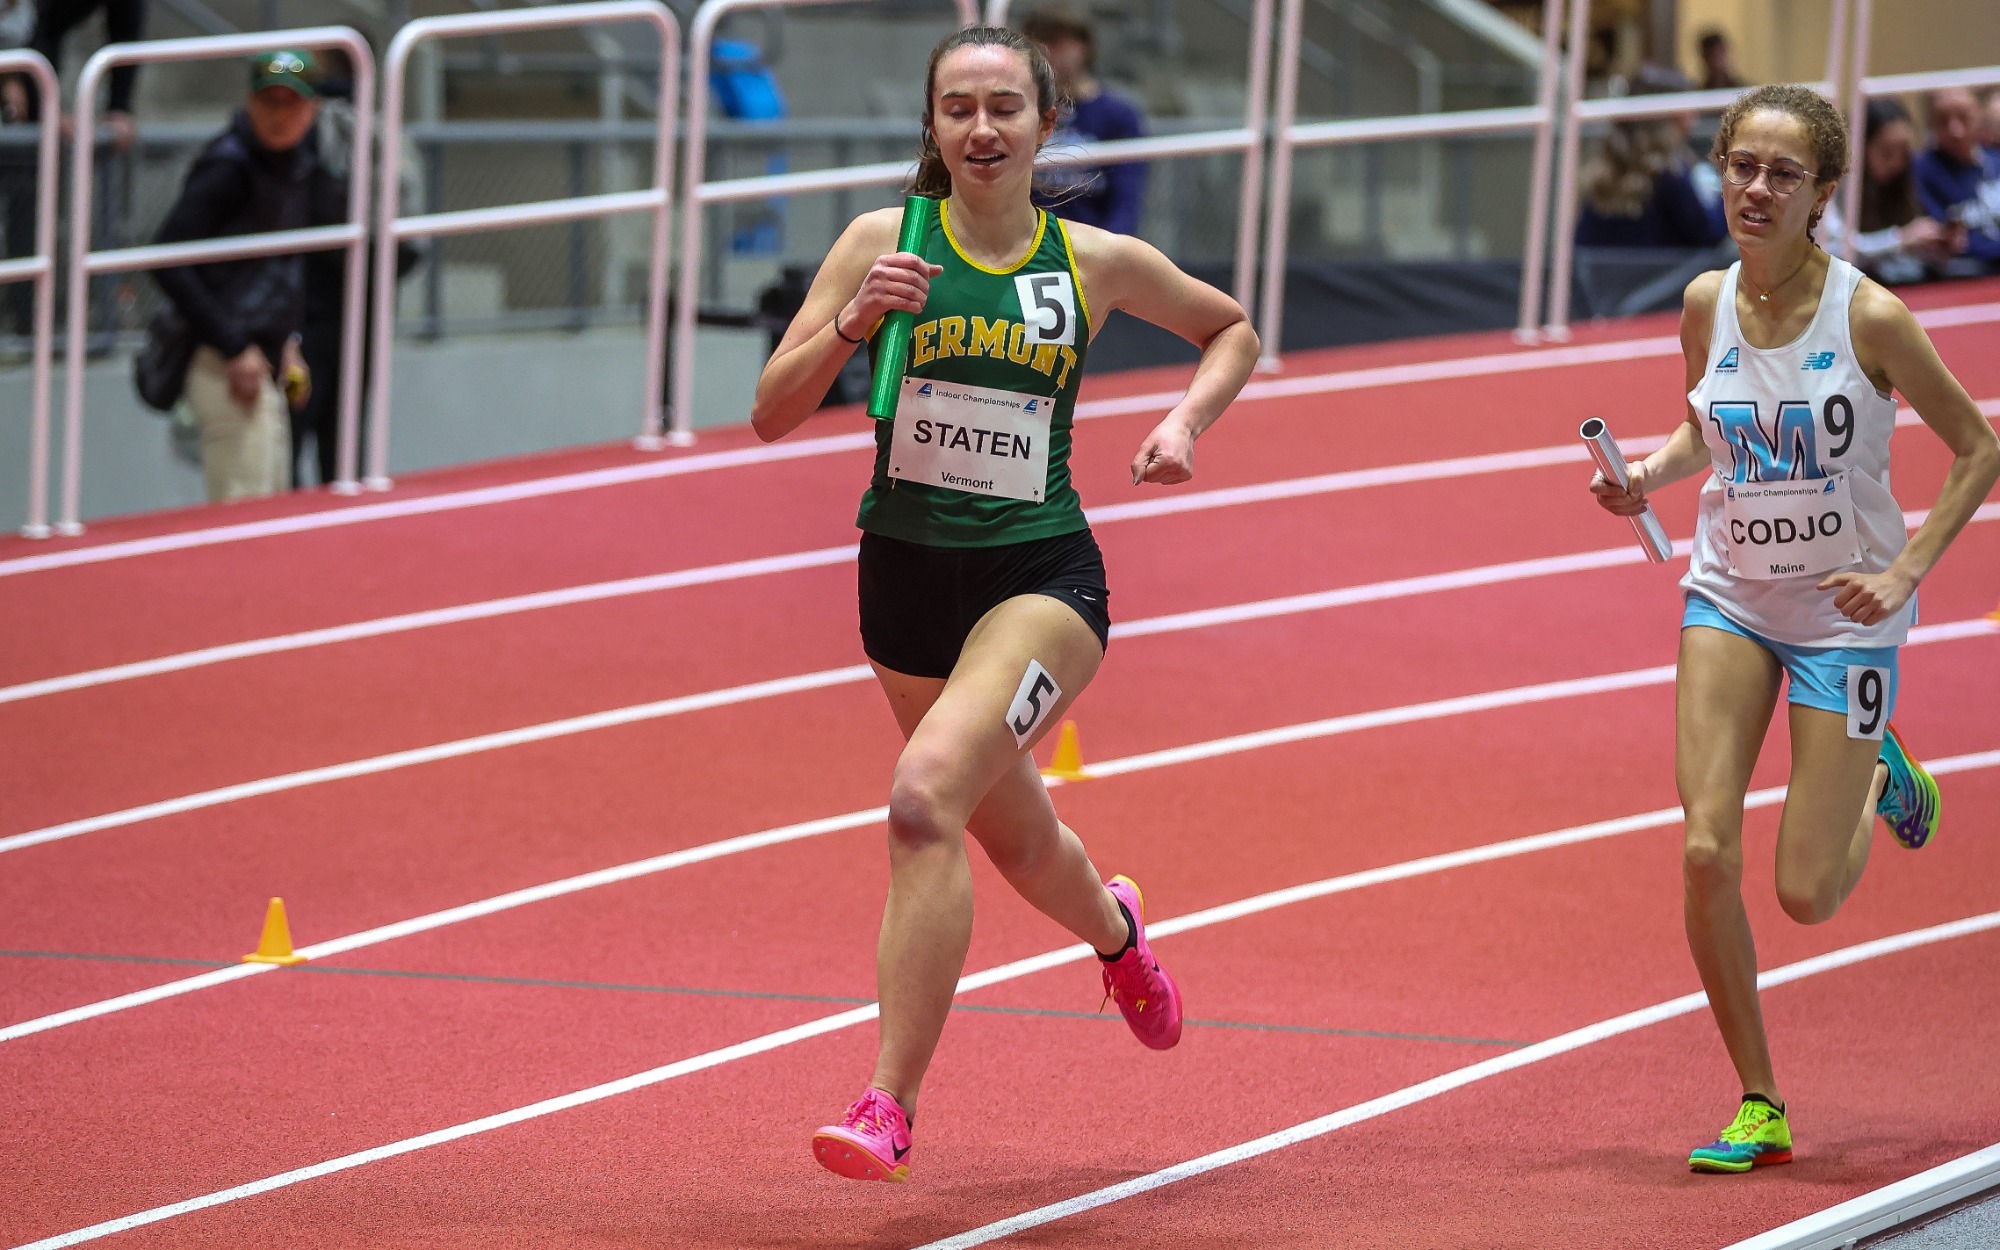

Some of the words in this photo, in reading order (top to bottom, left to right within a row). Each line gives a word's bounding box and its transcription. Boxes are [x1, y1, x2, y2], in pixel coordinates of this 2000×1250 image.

[1030, 276, 1066, 340] 5
[904, 315, 1078, 390] ERMONT
[935, 388, 960, 400] Indoor
[963, 394, 1021, 409] Championships
[913, 419, 1031, 460] STATEN
[1708, 401, 1828, 484] M
[1823, 394, 1855, 458] 9
[941, 471, 994, 490] Vermont
[1737, 489, 1761, 498] Indoor
[1763, 487, 1818, 499] Championships
[1730, 510, 1842, 545] CODJO
[1769, 562, 1806, 575] Maine
[1013, 671, 1055, 736] 5
[1857, 669, 1883, 735] 9
